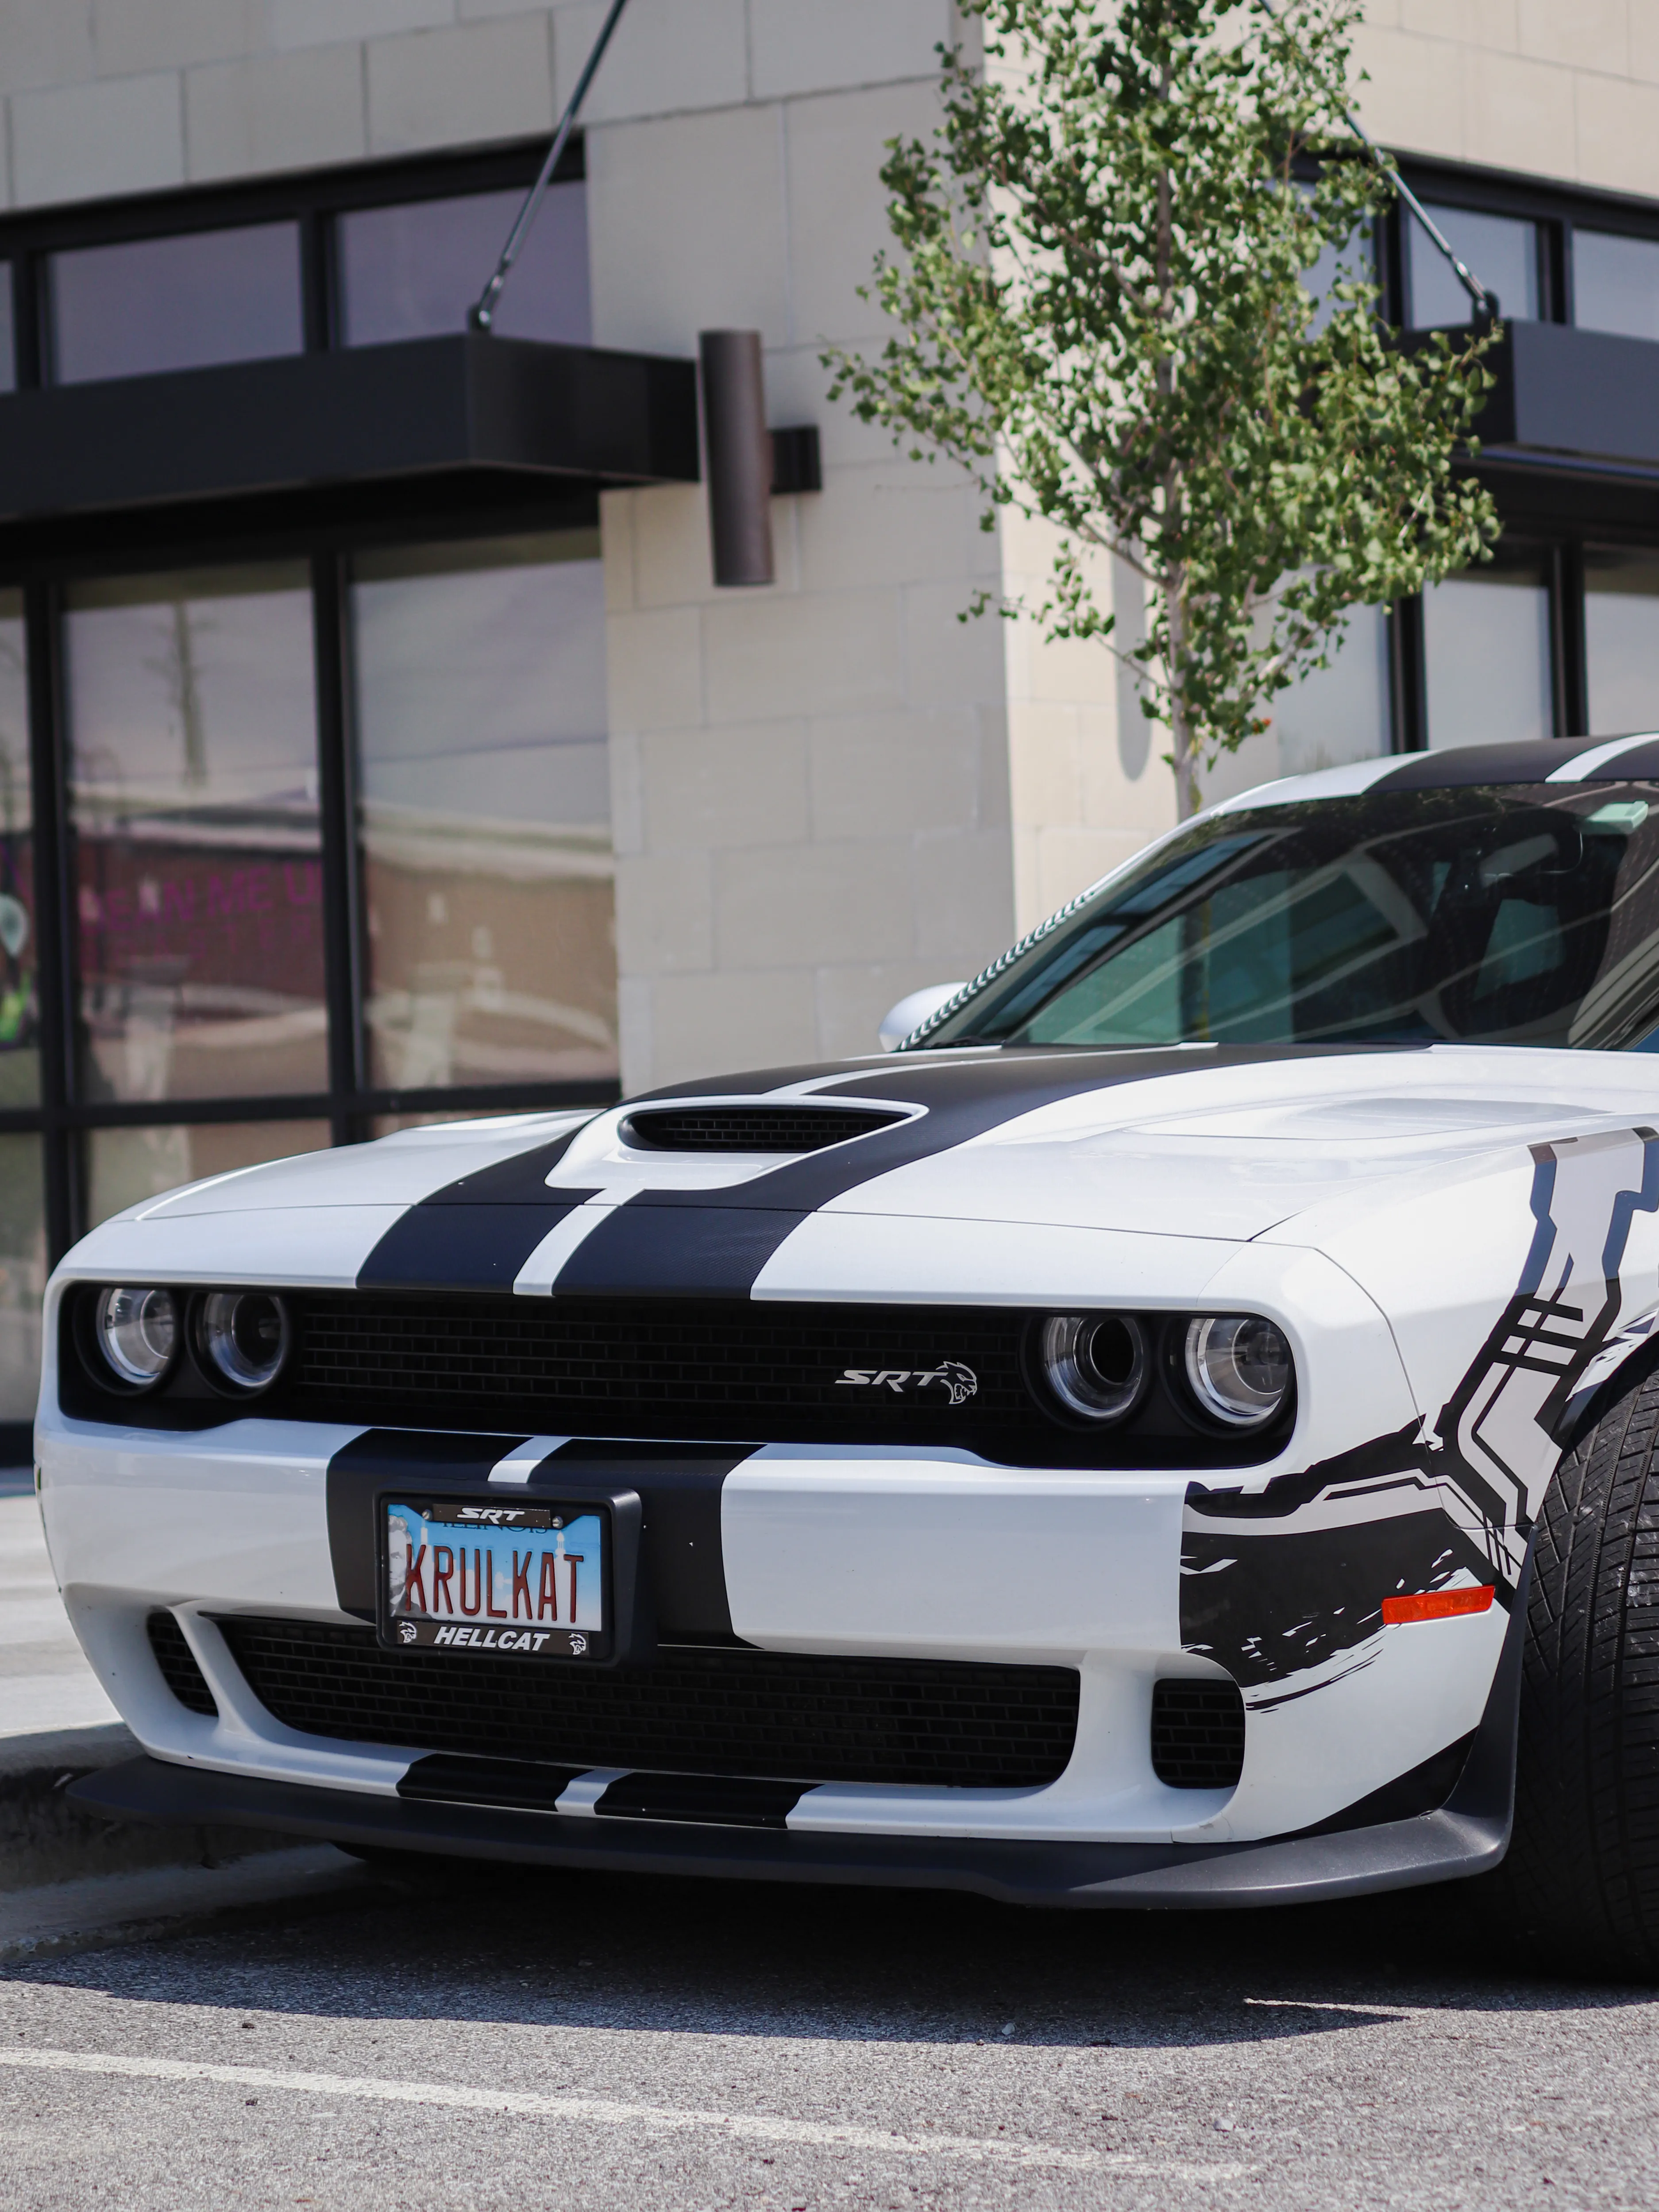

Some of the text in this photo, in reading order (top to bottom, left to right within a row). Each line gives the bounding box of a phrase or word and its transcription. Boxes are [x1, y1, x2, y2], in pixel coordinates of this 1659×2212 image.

[207, 867, 273, 916] ME
[835, 1370, 948, 1392] SRT
[457, 1507, 525, 1524] SRT
[405, 1543, 584, 1623] KRULKAT
[434, 1626, 550, 1651] HELLCAT
